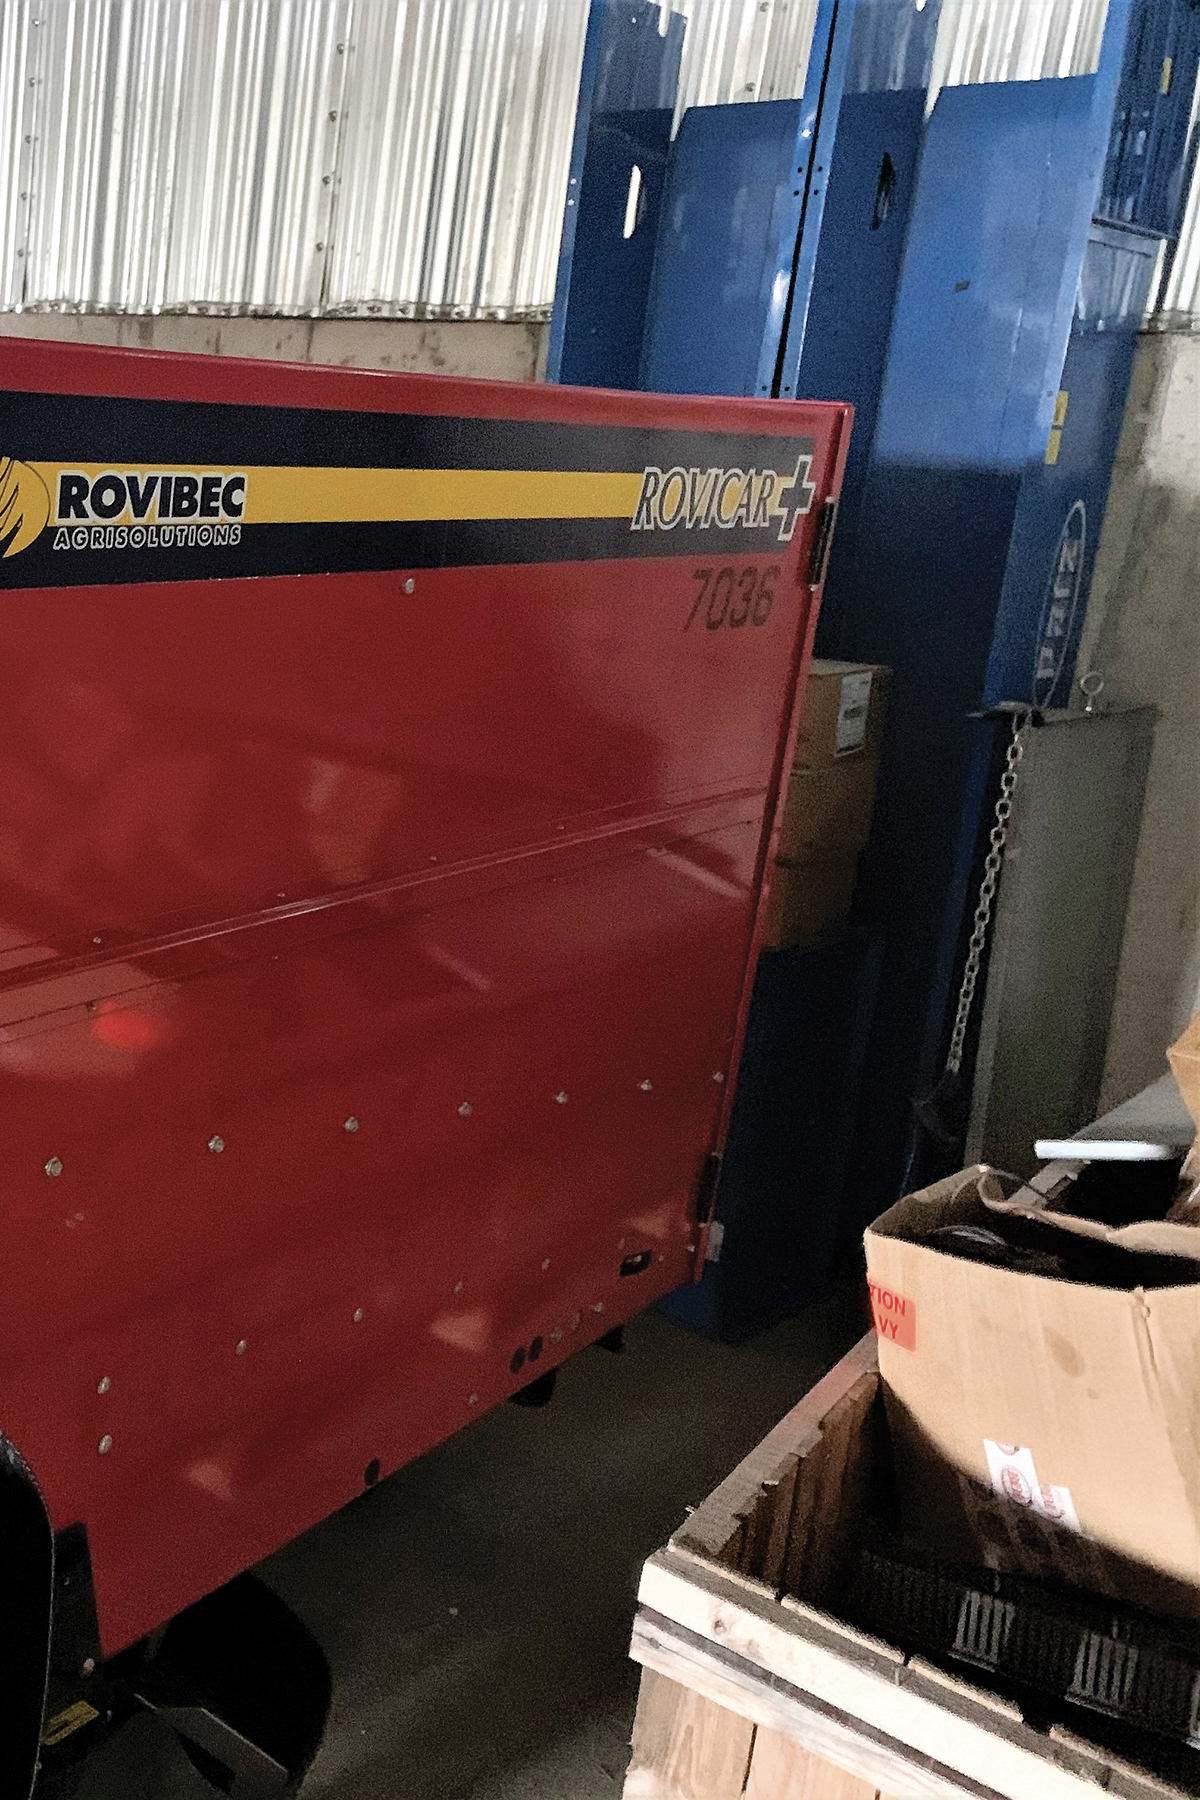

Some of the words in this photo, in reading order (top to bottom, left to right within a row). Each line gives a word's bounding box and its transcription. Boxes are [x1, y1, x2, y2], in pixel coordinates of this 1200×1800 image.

[56, 472, 247, 522] ROVIBEC
[53, 524, 241, 550] AGRISOLUTIONS
[684, 565, 781, 633] 7036
